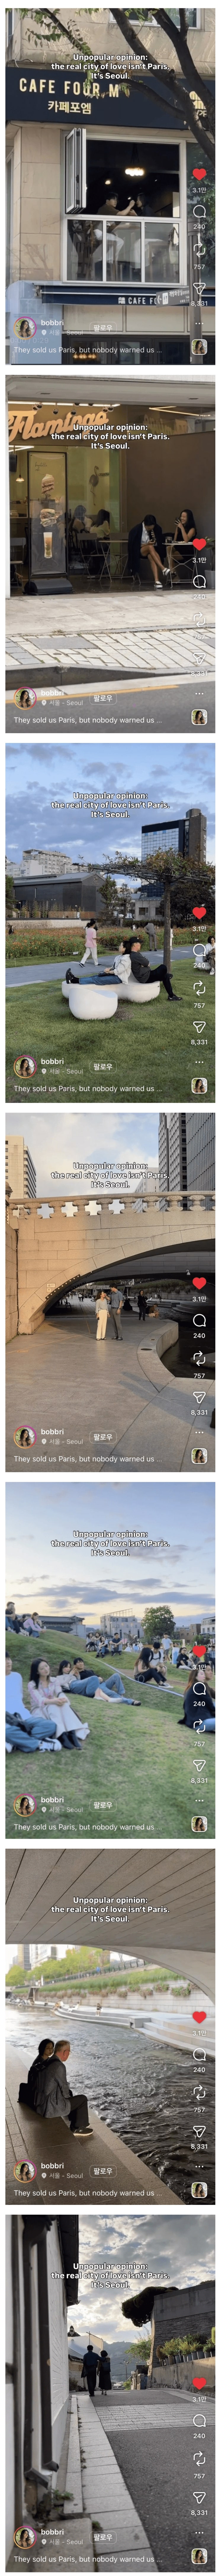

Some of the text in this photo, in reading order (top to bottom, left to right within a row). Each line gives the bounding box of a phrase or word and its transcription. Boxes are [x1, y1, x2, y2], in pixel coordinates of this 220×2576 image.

[19, 78, 119, 98] CAFE FOUR M
[48, 101, 91, 115] 카페포엠
[9, 410, 109, 443] Flamingo
